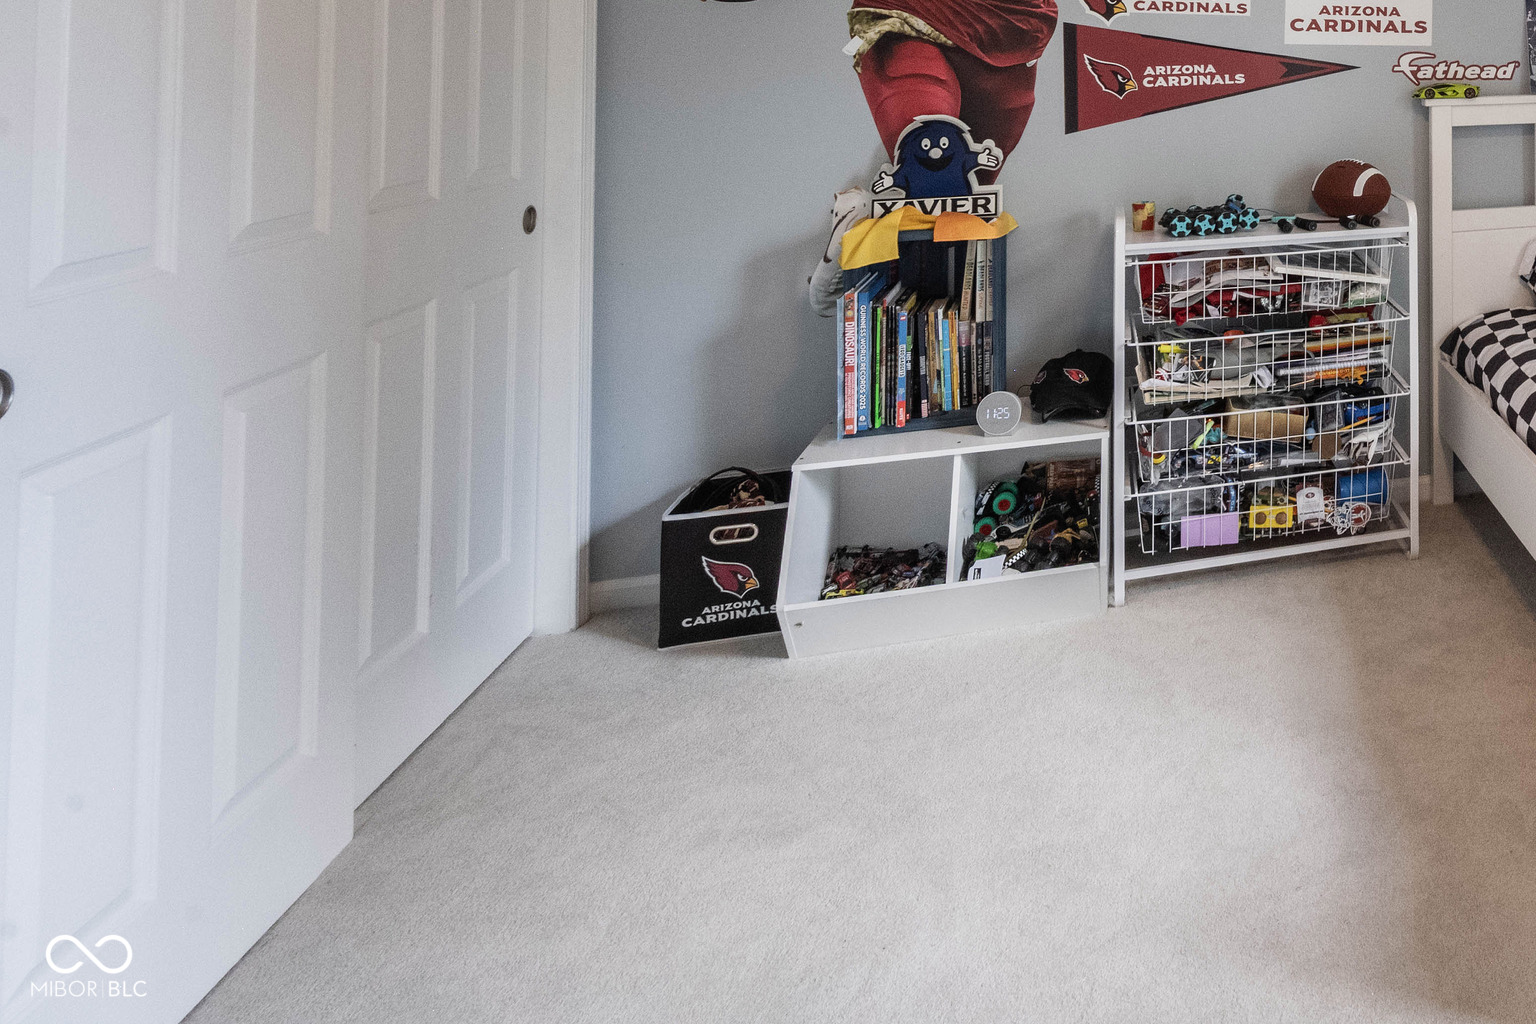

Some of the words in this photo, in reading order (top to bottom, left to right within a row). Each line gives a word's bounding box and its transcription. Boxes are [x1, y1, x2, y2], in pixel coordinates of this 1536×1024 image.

[1133, 0, 1248, 14] CARDINALS
[1318, 5, 1401, 17] ARIZONA
[1289, 18, 1428, 34] CARDINALS
[1143, 64, 1216, 75] ARIZONA
[1392, 51, 1518, 86] Fathead
[1142, 74, 1246, 88] CARDINALS
[845, 321, 855, 367] DINOSAUR!
[701, 599, 761, 615] ARIZONA
[681, 605, 778, 628] CARDINALS
